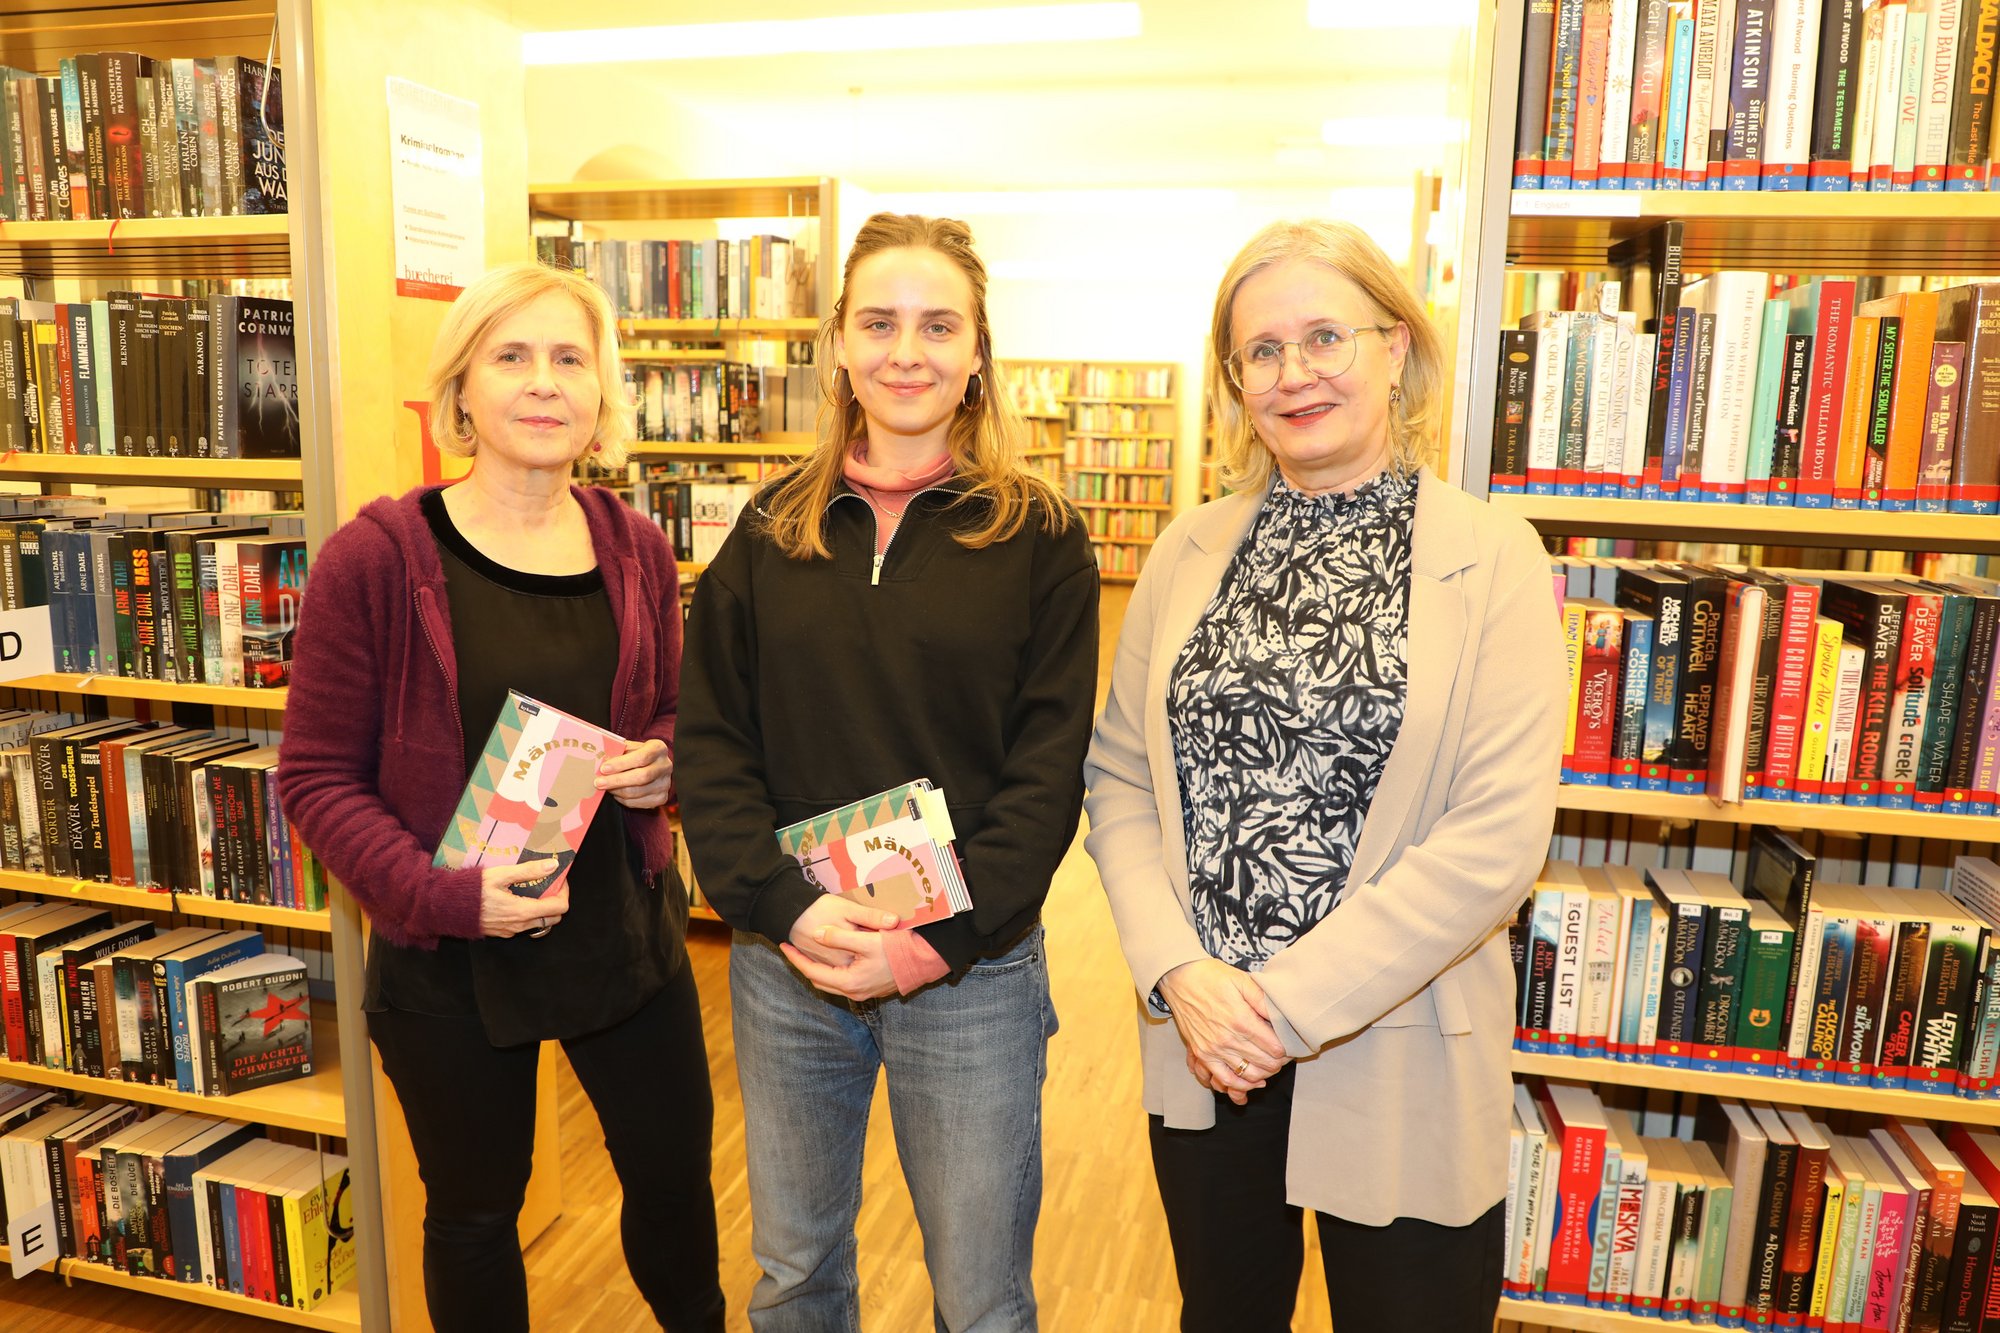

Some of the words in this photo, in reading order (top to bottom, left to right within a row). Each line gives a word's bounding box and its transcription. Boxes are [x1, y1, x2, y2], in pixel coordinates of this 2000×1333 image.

[1701, 0, 1717, 27] MAYA
[1741, 9, 1764, 89] ATKINSON
[1794, 18, 1805, 54] Atwood
[1840, 22, 1851, 64] ATWOOD
[1697, 30, 1714, 79] ANGELOU
[184, 76, 194, 115] NAMEN
[1787, 63, 1801, 100] Burning
[1837, 69, 1847, 87] THE
[1747, 100, 1760, 143] SHRINES
[1785, 103, 1798, 150] Questions
[1832, 90, 1845, 151] TESTAMENTS
[1902, 95, 1917, 125] OVE
[1973, 101, 1983, 120] The
[1733, 112, 1746, 147] GAIETY
[1970, 121, 1982, 143] Last
[180, 132, 191, 171] HARLAN
[189, 136, 199, 168] COBEN
[223, 139, 234, 180] HARLAN
[1745, 147, 1756, 159] OF
[1967, 143, 1977, 164] Mile
[255, 162, 279, 180] AUS
[1666, 246, 1681, 285] BLUTCH
[1704, 318, 1712, 332] the
[1830, 298, 1841, 323] THE
[75, 316, 90, 379] FLAMMENMEER
[119, 319, 128, 366] BLENDUNG
[196, 332, 204, 375] PARANOIA
[1700, 332, 1711, 370] selfless
[1793, 352, 1803, 369] Kill
[1794, 339, 1805, 350] To
[1822, 329, 1838, 388] ROMANTIC
[1574, 350, 1587, 396] WICKED
[1699, 373, 1707, 390] act
[1791, 372, 1800, 385] the
[28, 383, 39, 424] Connelly
[1570, 398, 1583, 429] KING
[1697, 391, 1705, 402] of
[1787, 385, 1799, 426] President
[1688, 402, 1703, 452] breathing
[1817, 393, 1832, 446] WILLIAM
[1930, 412, 1939, 435] CODE
[1507, 428, 1517, 452] TARA
[1565, 433, 1574, 466] BLACK
[1574, 433, 1583, 466] HOLLY
[1813, 450, 1825, 480] BOYD
[132, 549, 150, 586] HASS
[174, 553, 193, 590] NEID
[242, 562, 260, 594] DAHL
[136, 591, 153, 617] DAHL
[179, 596, 194, 621] DAHL
[244, 595, 263, 627] ARNE
[1658, 597, 1672, 646] CONNELLY
[1671, 600, 1681, 642] MICHAEL
[1787, 591, 1812, 643] DEBORAH
[0, 631, 22, 661] D
[137, 620, 155, 646] ARNE
[181, 623, 197, 651] ARNE
[1688, 600, 1712, 673] Cornwell
[1704, 612, 1720, 661] Patricia
[1874, 605, 1893, 659] DEAVER
[1890, 611, 1901, 646] JEFFERY
[1910, 608, 1929, 662] DEAVER
[1924, 613, 1937, 649] JEFFERY
[1656, 656, 1665, 669] OF
[1667, 655, 1676, 673] TWO
[1781, 648, 1806, 699] CROMBIE
[1818, 633, 1839, 681] Spoiler
[1947, 665, 1956, 680] THE
[1624, 648, 1639, 718] CONNELLY
[1634, 653, 1649, 713] MICHAEL
[1654, 671, 1663, 703] TRUTH
[1663, 675, 1674, 705] KINDS
[1842, 669, 1860, 685] THE
[1872, 665, 1889, 690] THE
[1584, 680, 1593, 716] HOUSE
[1814, 682, 1831, 716] Alert
[1835, 688, 1858, 733] PASSENGER
[1866, 691, 1887, 729] KILL
[1937, 683, 1956, 724] SHAPE
[1682, 693, 1694, 741] HEART
[1695, 685, 1711, 750] DEPRAVED
[1938, 727, 1946, 738] OF
[513, 738, 606, 781] Männer
[1773, 725, 1795, 759] BITTER
[1858, 732, 1881, 778] ROOM
[1895, 733, 1914, 778] creek
[40, 744, 53, 790] DEAVER
[66, 745, 78, 798] TODESSPIELER
[1928, 740, 1945, 782] WATER
[86, 776, 100, 830] Teufelsspiel
[69, 803, 83, 850] DEAVER
[94, 831, 103, 849] Das
[863, 835, 935, 913] Männer
[96, 943, 116, 959] WULF
[118, 934, 140, 949] DORN
[1564, 910, 1581, 966] GUEST
[1686, 922, 1699, 952] DIANA
[1726, 927, 1739, 957] DIANA
[4, 951, 20, 992] ULTIMATUM
[1534, 941, 1547, 977] FOLLETT
[1544, 951, 1554, 969] KEN
[1821, 933, 1840, 996] GALBRAITH
[1856, 937, 1873, 999] GALBRAITH
[1894, 939, 1911, 1001] GALBRAITH
[1936, 942, 1956, 1005] GALBRAITH
[1949, 959, 1961, 992] ROBERT
[221, 978, 262, 993] ROBERT
[265, 972, 303, 986] DUGONI
[1559, 972, 1575, 1008] LIST
[1794, 1000, 1809, 1047] GAINES
[1829, 1000, 1837, 1011] THE
[1812, 1003, 1828, 1053] CALLING
[1821, 1011, 1838, 1060] CUCKOO
[1895, 1011, 1912, 1057] CAREER
[1937, 1011, 1958, 1064] LETHAL
[174, 1036, 182, 1060] GOLD
[234, 1056, 257, 1068] DIE
[260, 1045, 304, 1061] ACHTE
[231, 1054, 309, 1079] SCHWESTER
[1573, 1136, 1583, 1173] GREENE
[1583, 1138, 1593, 1174] ROBERT
[1777, 1150, 1792, 1179] JOHN
[1807, 1161, 1821, 1194] JOHN
[129, 1207, 139, 1235] MATTIAS
[134, 1202, 146, 1243] EDVARDSSON
[1566, 1193, 1577, 1226] HUMAN
[1769, 1181, 1788, 1228] GRISHAM
[1864, 1203, 1875, 1234] JENNY
[1932, 1193, 1947, 1237] HANNAH
[1944, 1194, 1958, 1238] KRISTIN
[21, 1223, 44, 1258] E
[1797, 1197, 1816, 1252] GRISHAM
[1562, 1230, 1572, 1265] NATURE
[1860, 1239, 1870, 1260] HAN
[1760, 1243, 1779, 1291] ROOSTER
[1926, 1256, 1938, 1280] Great
[1961, 1256, 1978, 1289] Homo
[1757, 1294, 1771, 1315] BAR
[1921, 1285, 1933, 1312] Alone
[1957, 1290, 1972, 1317] Deus
